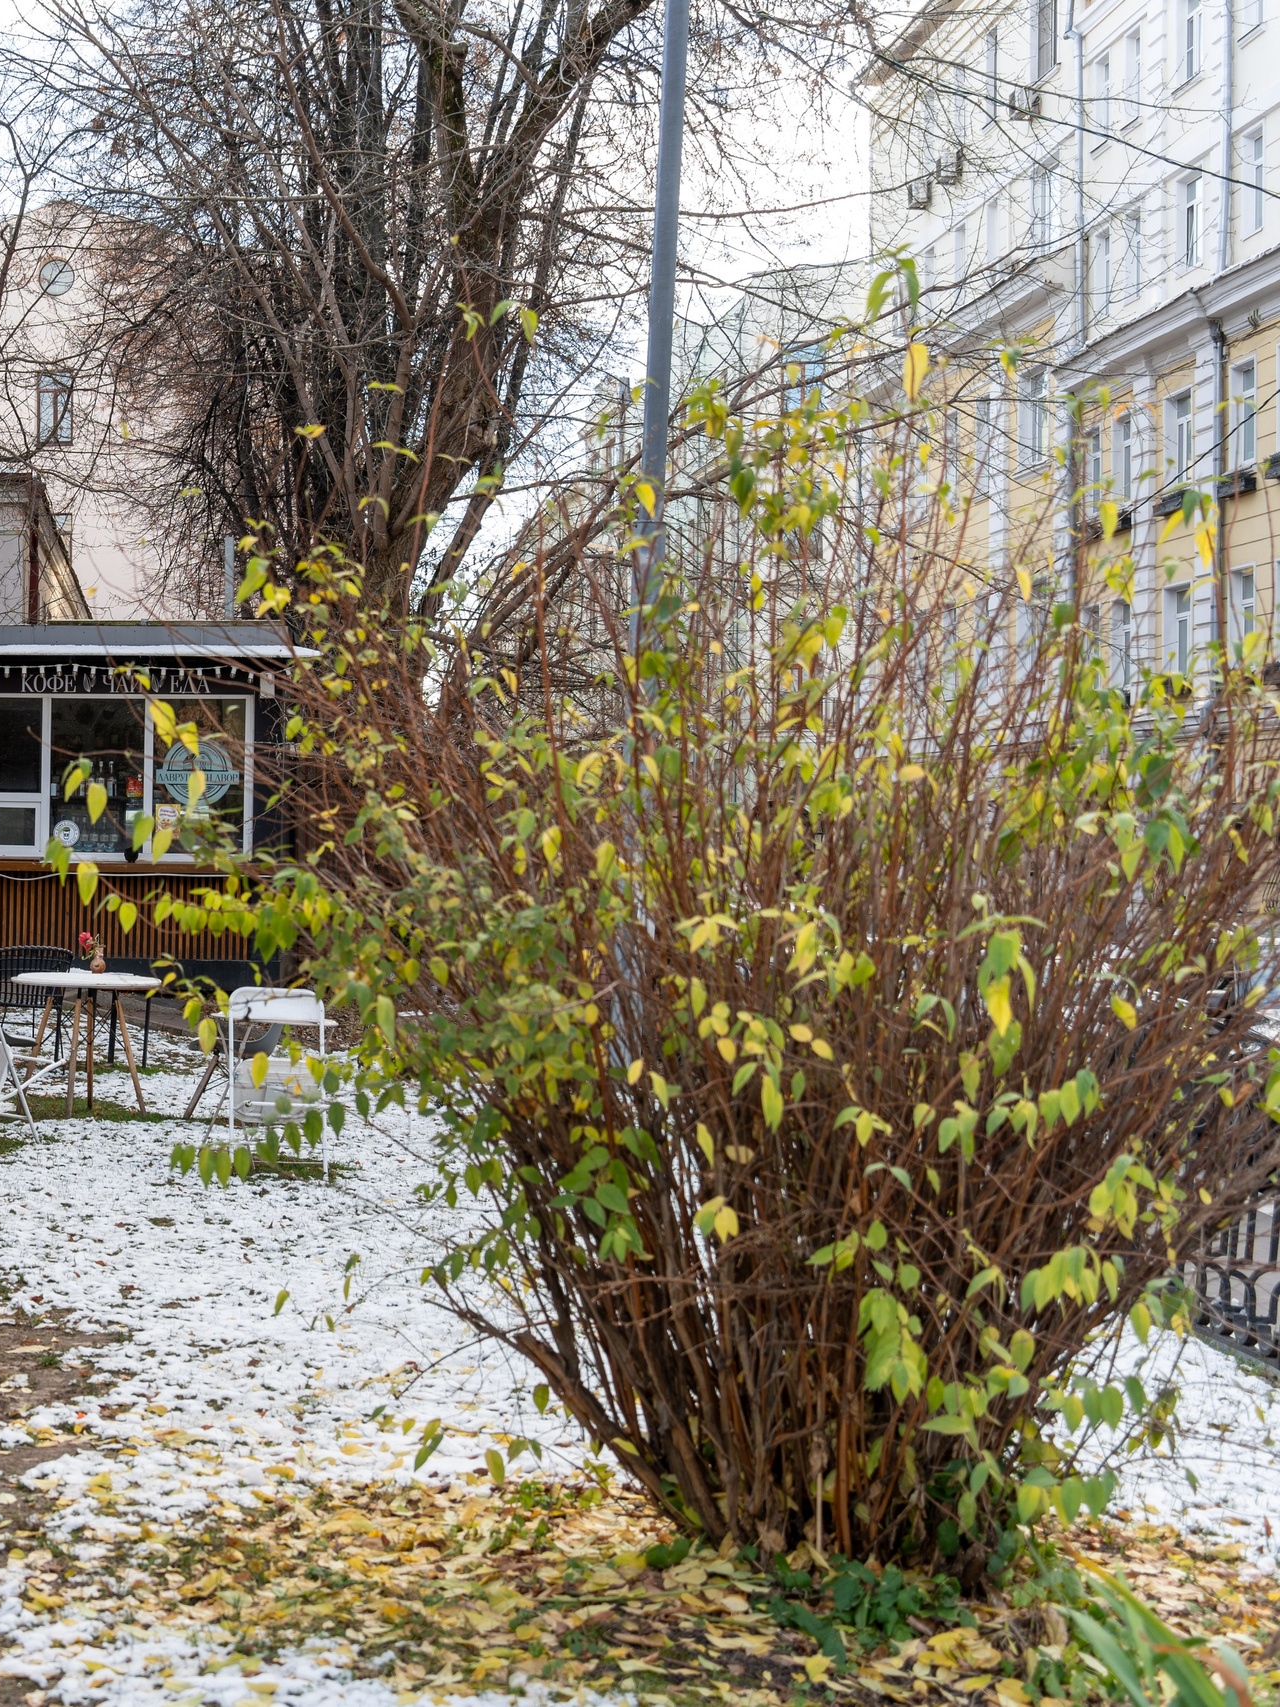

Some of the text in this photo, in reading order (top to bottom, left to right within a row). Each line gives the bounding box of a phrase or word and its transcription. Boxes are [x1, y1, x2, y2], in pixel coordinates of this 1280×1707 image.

[20, 673, 77, 693] КОФЕ
[169, 674, 211, 693] ЕДА
[158, 773, 213, 782] ЛАВРУН
